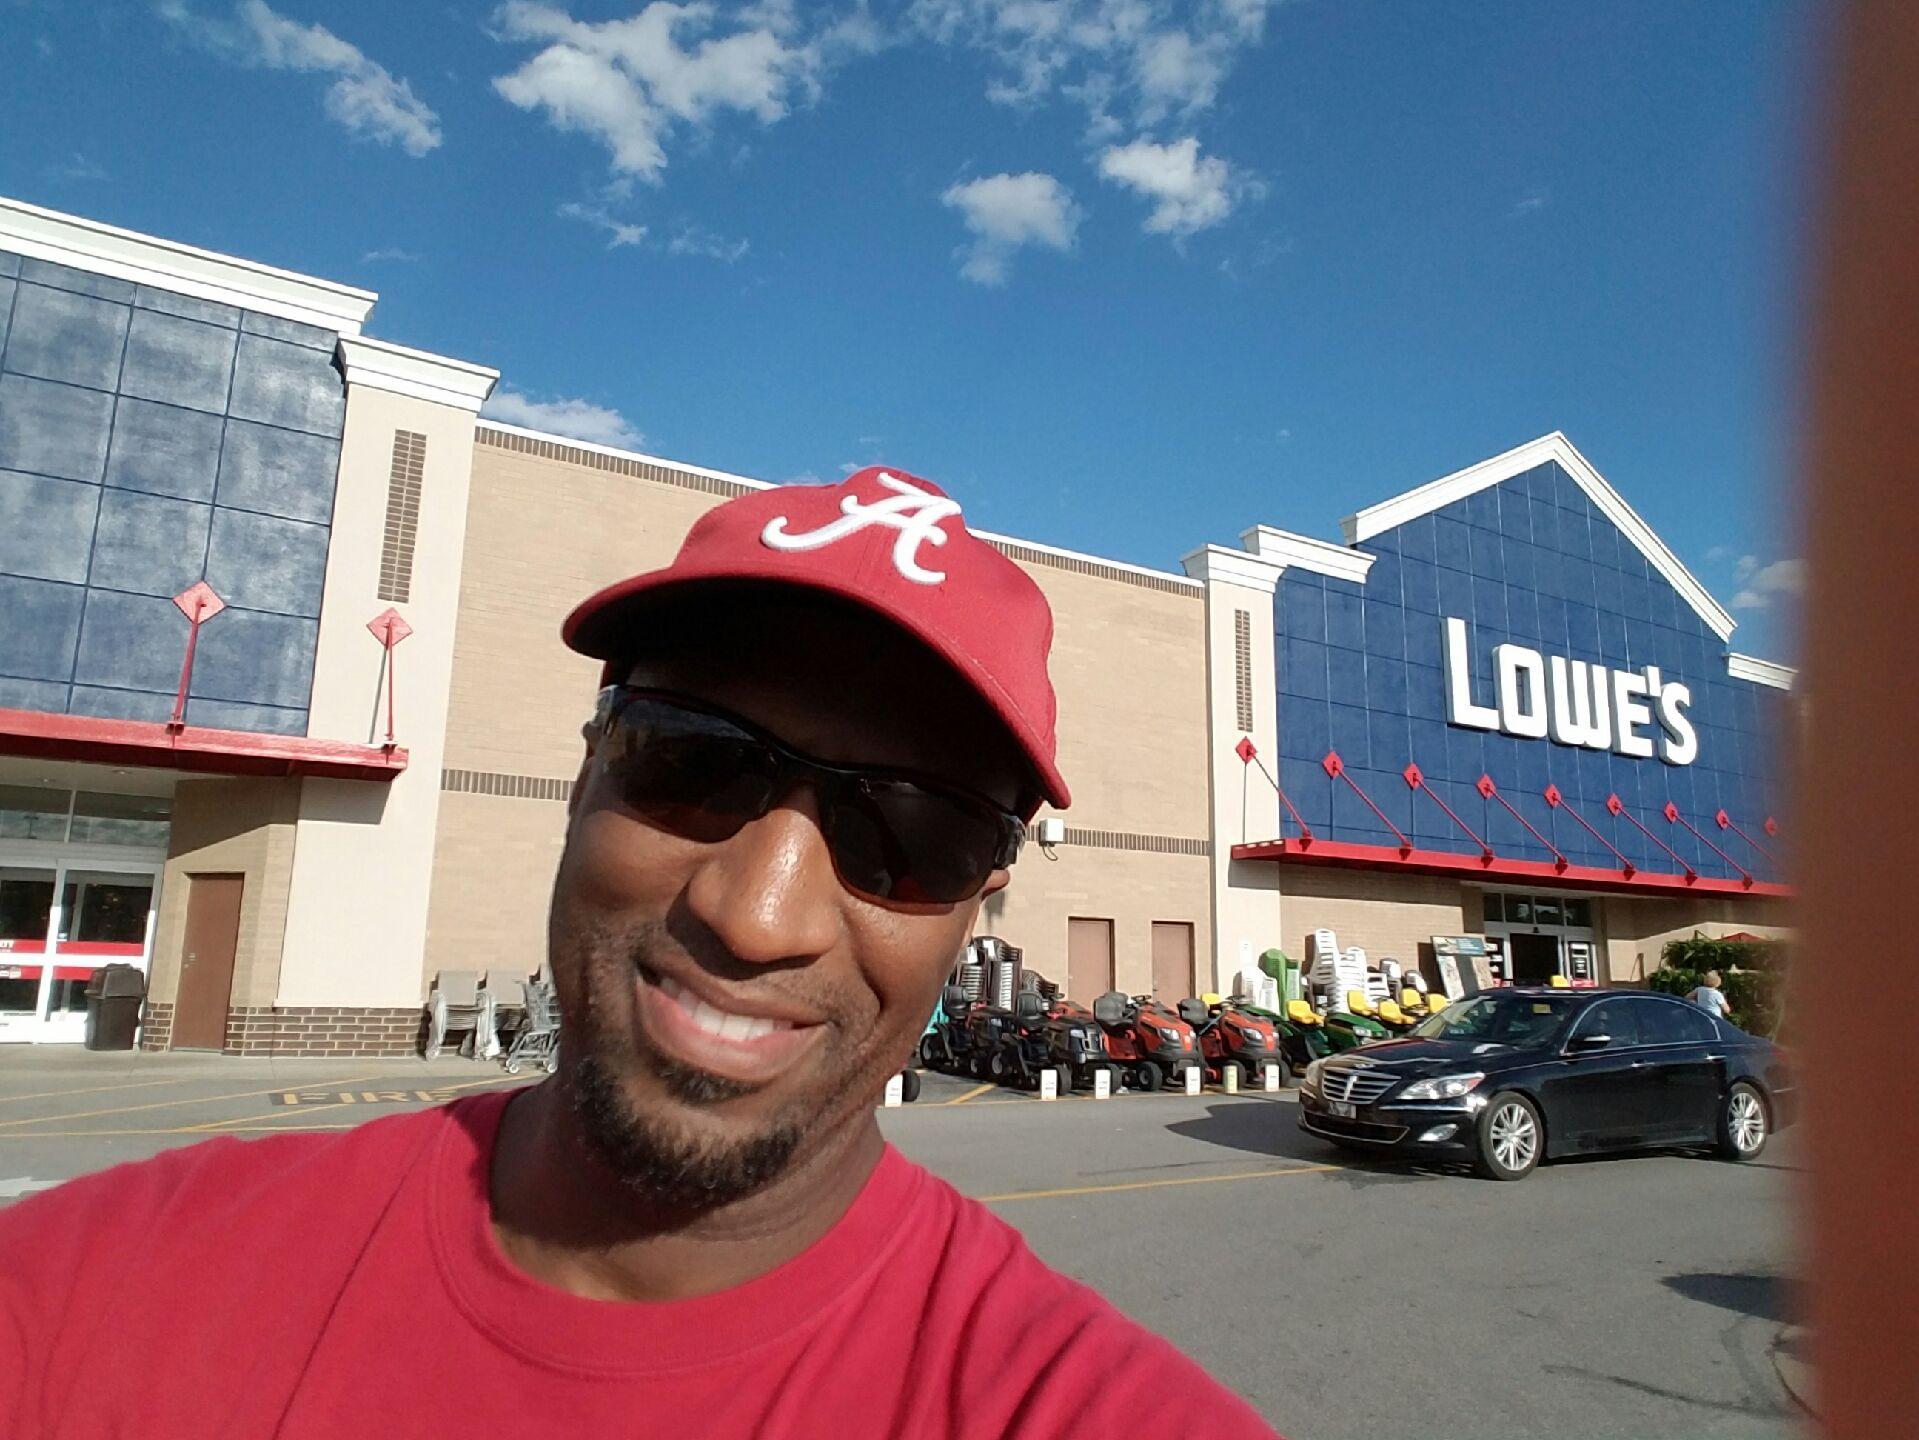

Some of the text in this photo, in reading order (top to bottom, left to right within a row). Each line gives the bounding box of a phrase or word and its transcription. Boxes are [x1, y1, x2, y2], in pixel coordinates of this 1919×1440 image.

[760, 472, 962, 584] A
[1443, 616, 1697, 765] LOWE'S
[283, 1089, 457, 1105] FIRE
